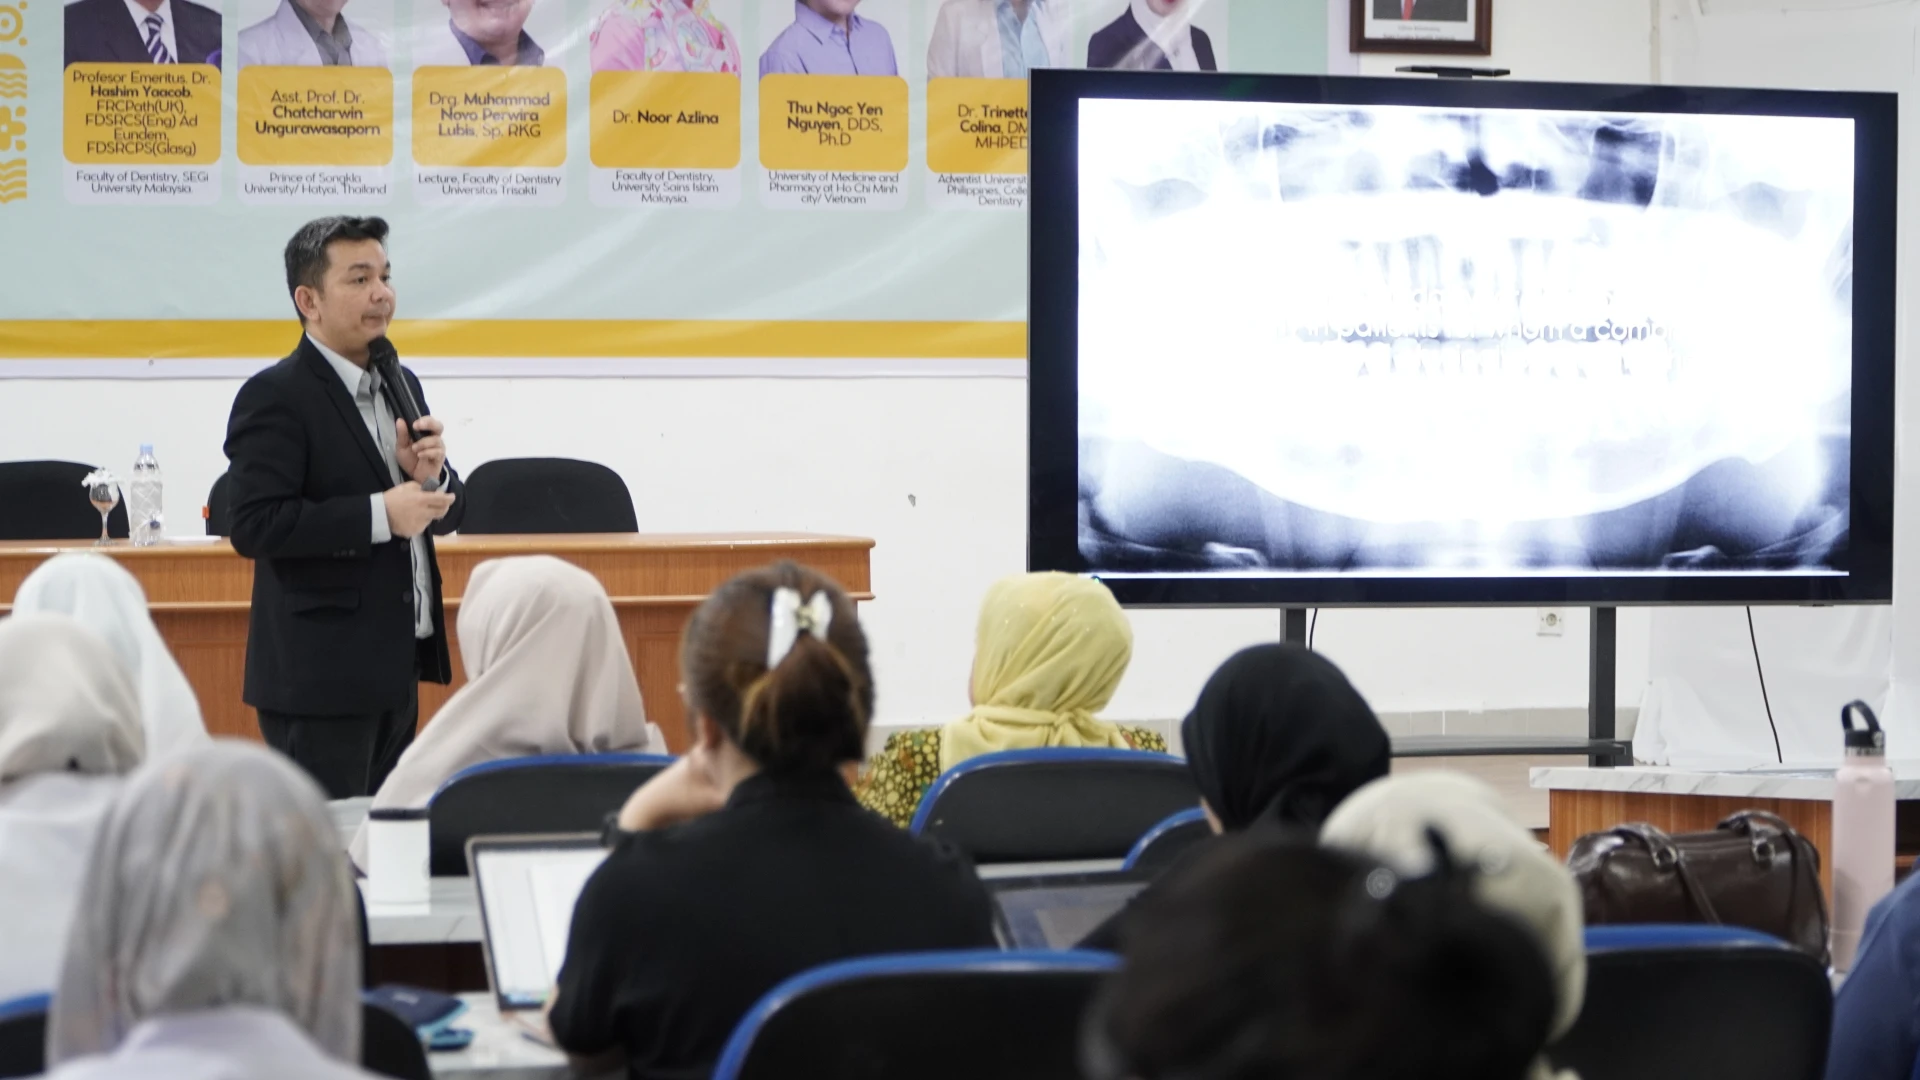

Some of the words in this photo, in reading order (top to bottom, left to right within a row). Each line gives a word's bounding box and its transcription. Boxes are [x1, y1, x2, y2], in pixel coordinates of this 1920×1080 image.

[73, 70, 126, 83] Profesor
[192, 71, 211, 84] Dr.
[91, 85, 139, 97] Hashim
[307, 90, 340, 104] Prof.
[344, 90, 365, 104] Dr.
[464, 92, 550, 106] Muhammad
[272, 105, 363, 120] Chatcharwin
[441, 107, 478, 121] Novo
[482, 108, 539, 122] Perwira
[787, 100, 813, 114] Thu
[817, 100, 853, 118] Ngoc
[857, 101, 884, 116] Yen
[958, 104, 978, 118] Dr.
[85, 113, 176, 129] FDSRCS(Eng)
[180, 114, 198, 127] Ad
[613, 109, 634, 124] Dr.
[637, 110, 672, 124] Noor
[676, 110, 719, 124] Azlina
[255, 120, 380, 139] Ungurawasaporn
[508, 124, 541, 138] RKG
[787, 116, 844, 133] Nguyen,
[847, 117, 883, 133] DDS,
[960, 119, 1004, 134] Colina,
[819, 132, 852, 146] Ph.D
[76, 170, 114, 183] Faculty
[117, 170, 128, 181] of
[269, 172, 303, 183] Prince
[305, 172, 316, 183] of
[319, 172, 361, 185] Songkla
[463, 173, 500, 186] Faculty
[502, 174, 512, 184] of
[515, 174, 561, 187] Dentistry
[616, 170, 652, 183] Faculty
[654, 170, 665, 181] of
[768, 170, 816, 183] University
[818, 171, 829, 181] of
[831, 172, 876, 182] Medicine
[878, 172, 899, 183] and
[938, 174, 981, 184] Adventist
[91, 183, 141, 195] University
[342, 183, 387, 195] Thailand
[442, 184, 497, 196] Universitas
[501, 185, 537, 196] Trisakti
[612, 181, 660, 194] University
[663, 182, 690, 193] Sains
[692, 182, 719, 193] Islam
[769, 181, 821, 194] Pharmacy
[823, 182, 834, 193] at
[836, 182, 852, 193] Ho
[854, 183, 871, 193] Chi
[873, 183, 898, 194] Minh
[824, 194, 866, 204] Vietnam
[978, 196, 1023, 207] Dentistry
